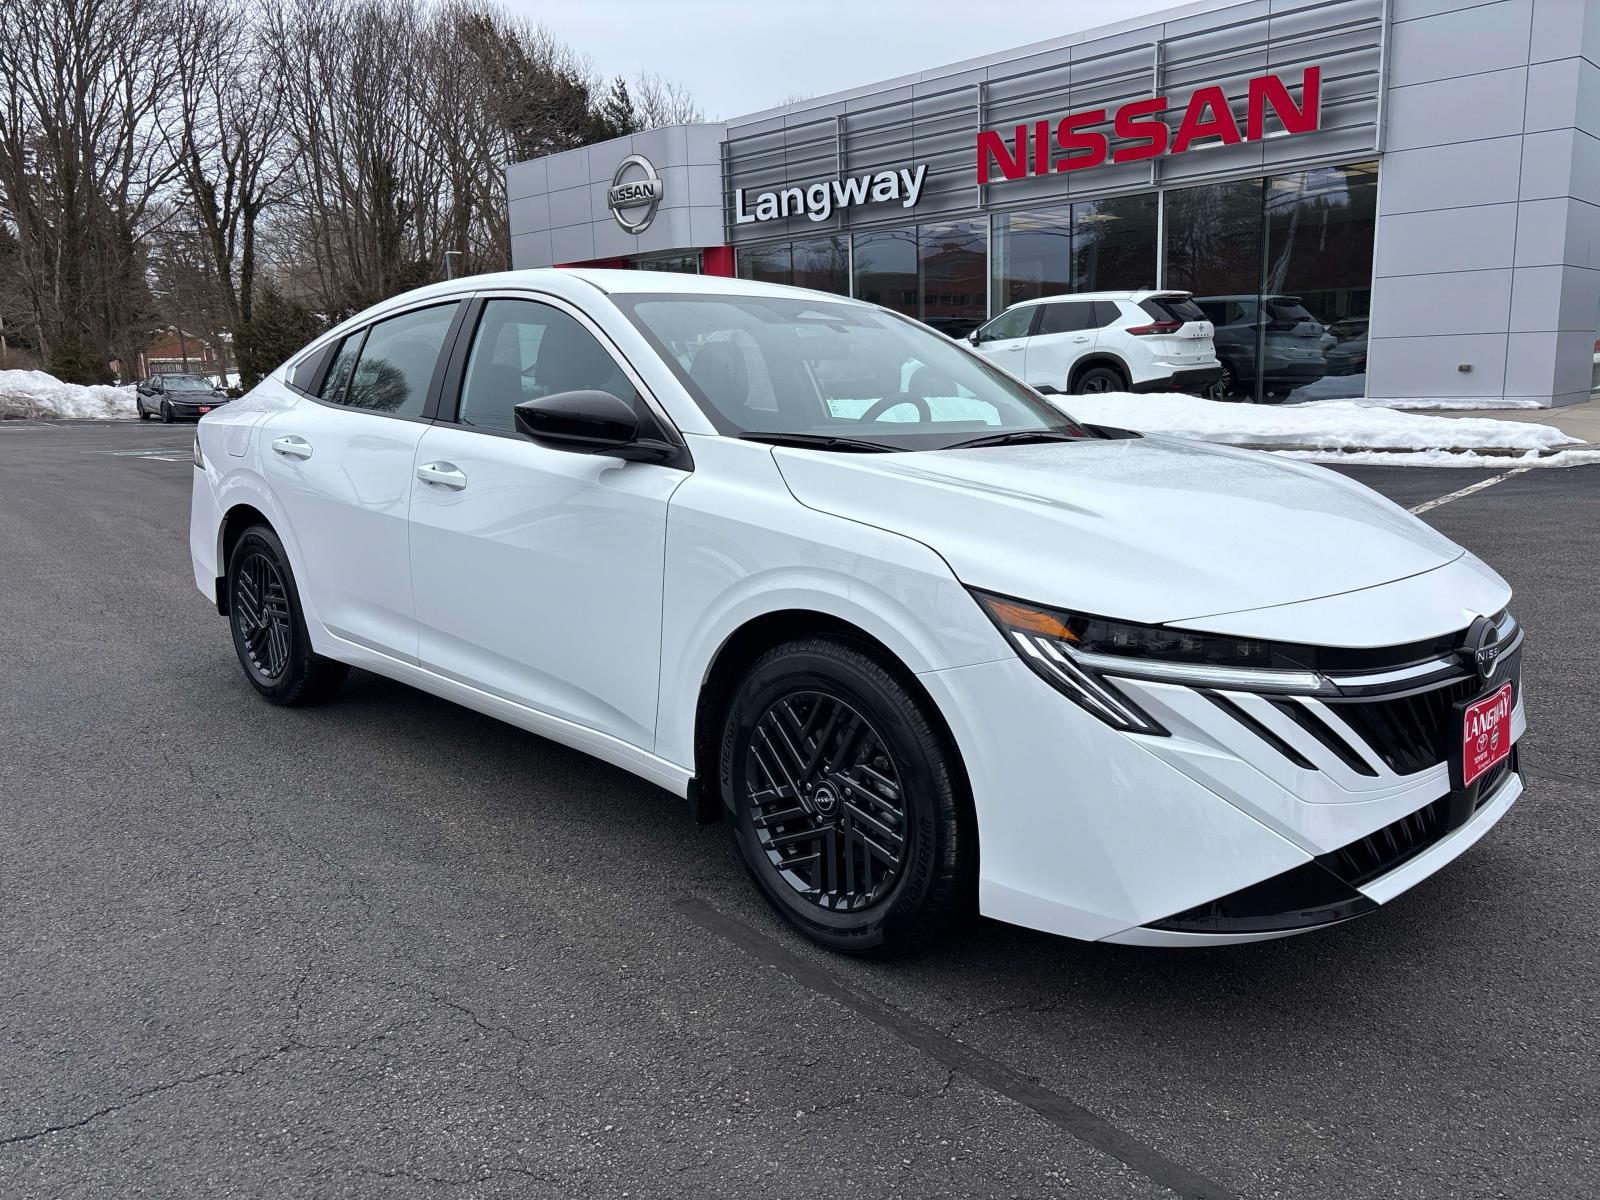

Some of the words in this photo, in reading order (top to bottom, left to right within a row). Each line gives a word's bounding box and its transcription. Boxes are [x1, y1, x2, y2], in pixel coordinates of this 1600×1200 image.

[977, 66, 1321, 185] NISSAN
[608, 184, 654, 204] NISSAN
[736, 165, 928, 224] Langway
[1465, 696, 1509, 743] LANGWAY
